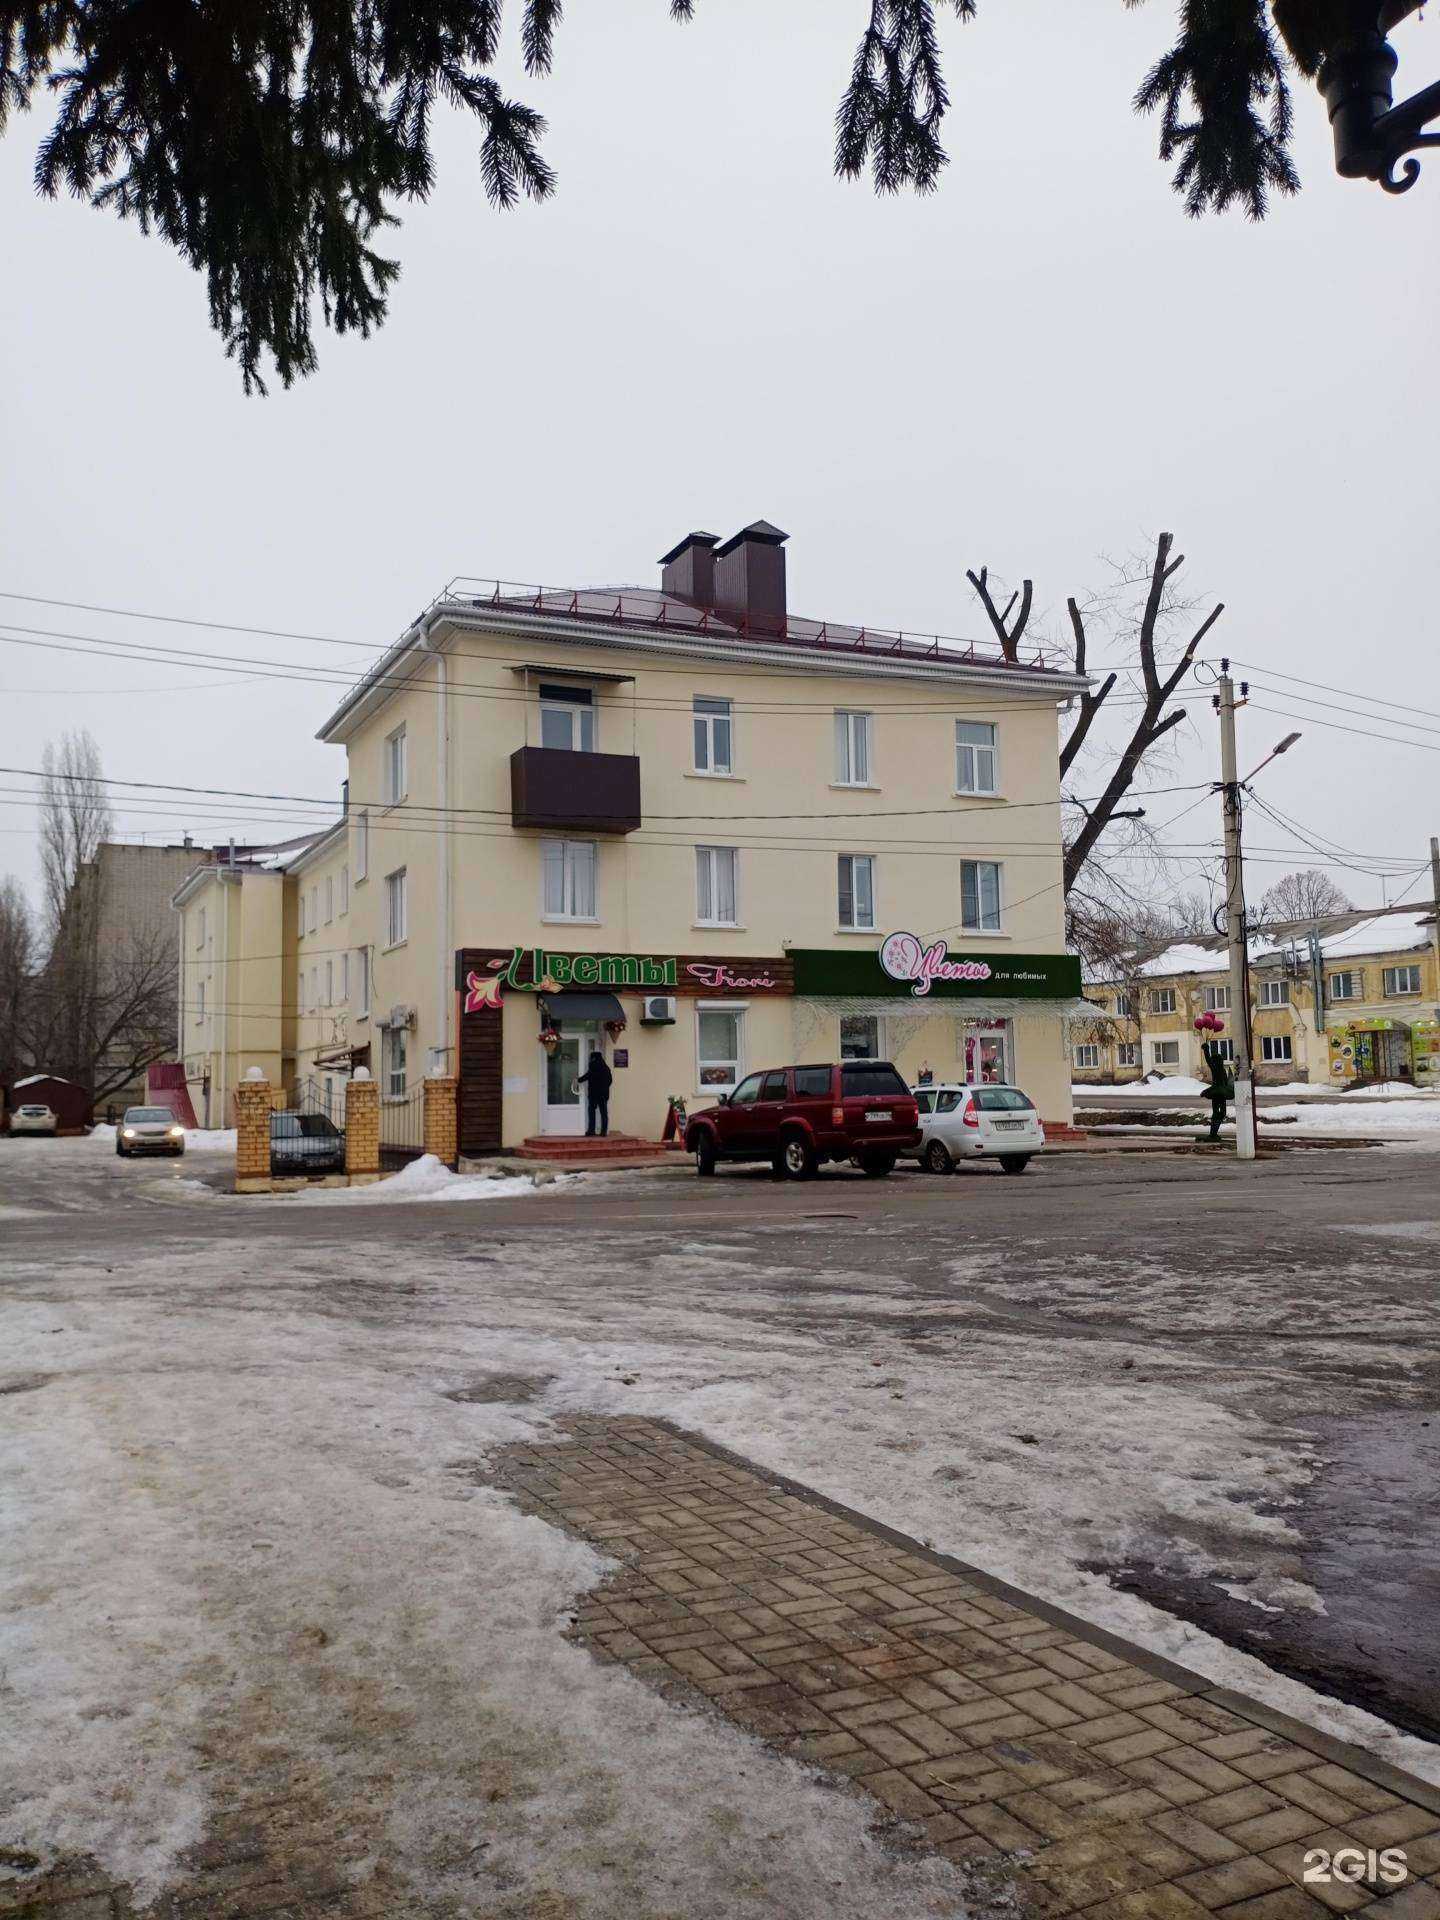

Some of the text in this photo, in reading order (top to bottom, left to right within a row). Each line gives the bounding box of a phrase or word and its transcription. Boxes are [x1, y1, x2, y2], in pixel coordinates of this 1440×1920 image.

[900, 938, 990, 995] Цветы
[995, 972, 1047, 980] для любимых
